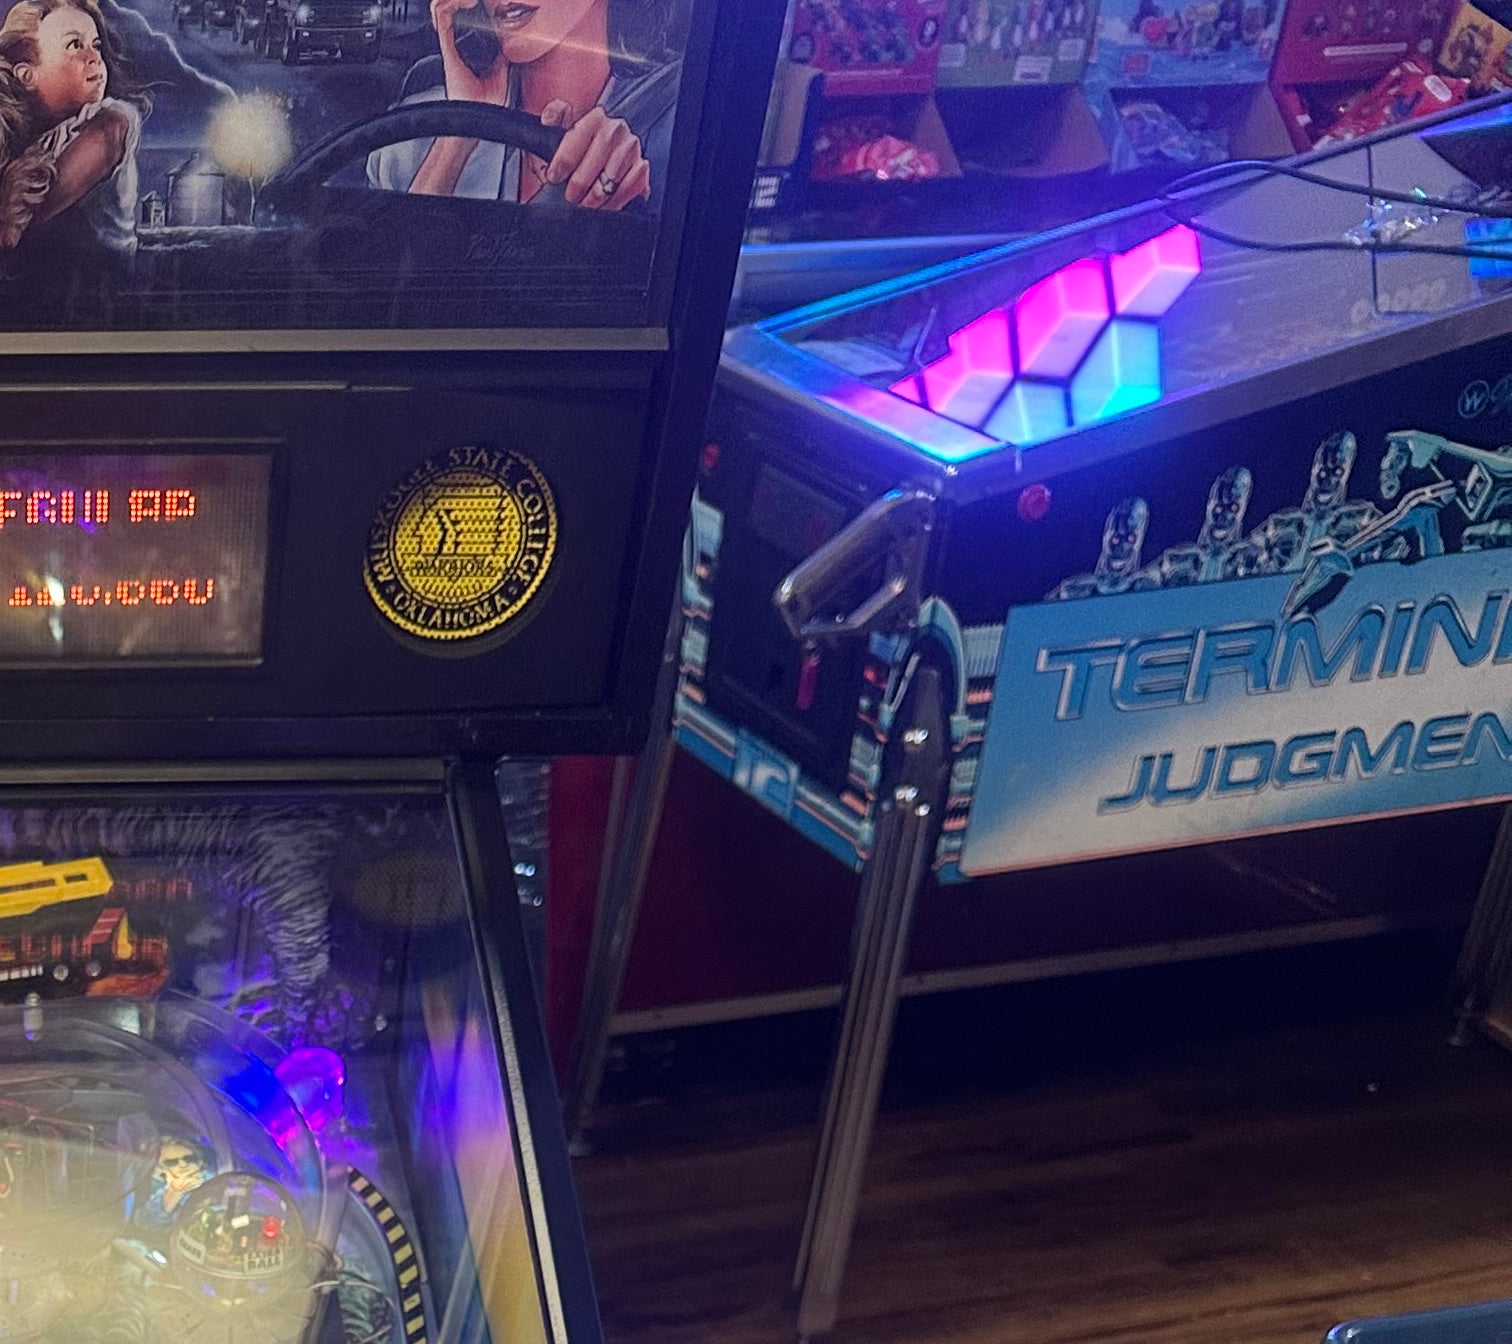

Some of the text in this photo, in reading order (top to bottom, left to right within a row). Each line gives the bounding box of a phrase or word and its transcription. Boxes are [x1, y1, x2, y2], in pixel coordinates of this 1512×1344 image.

[448, 447, 517, 476] STATE
[514, 478, 547, 587] COLLEGE
[393, 593, 511, 629] OKLAHOMA
[1036, 588, 1512, 720] TERMIN
